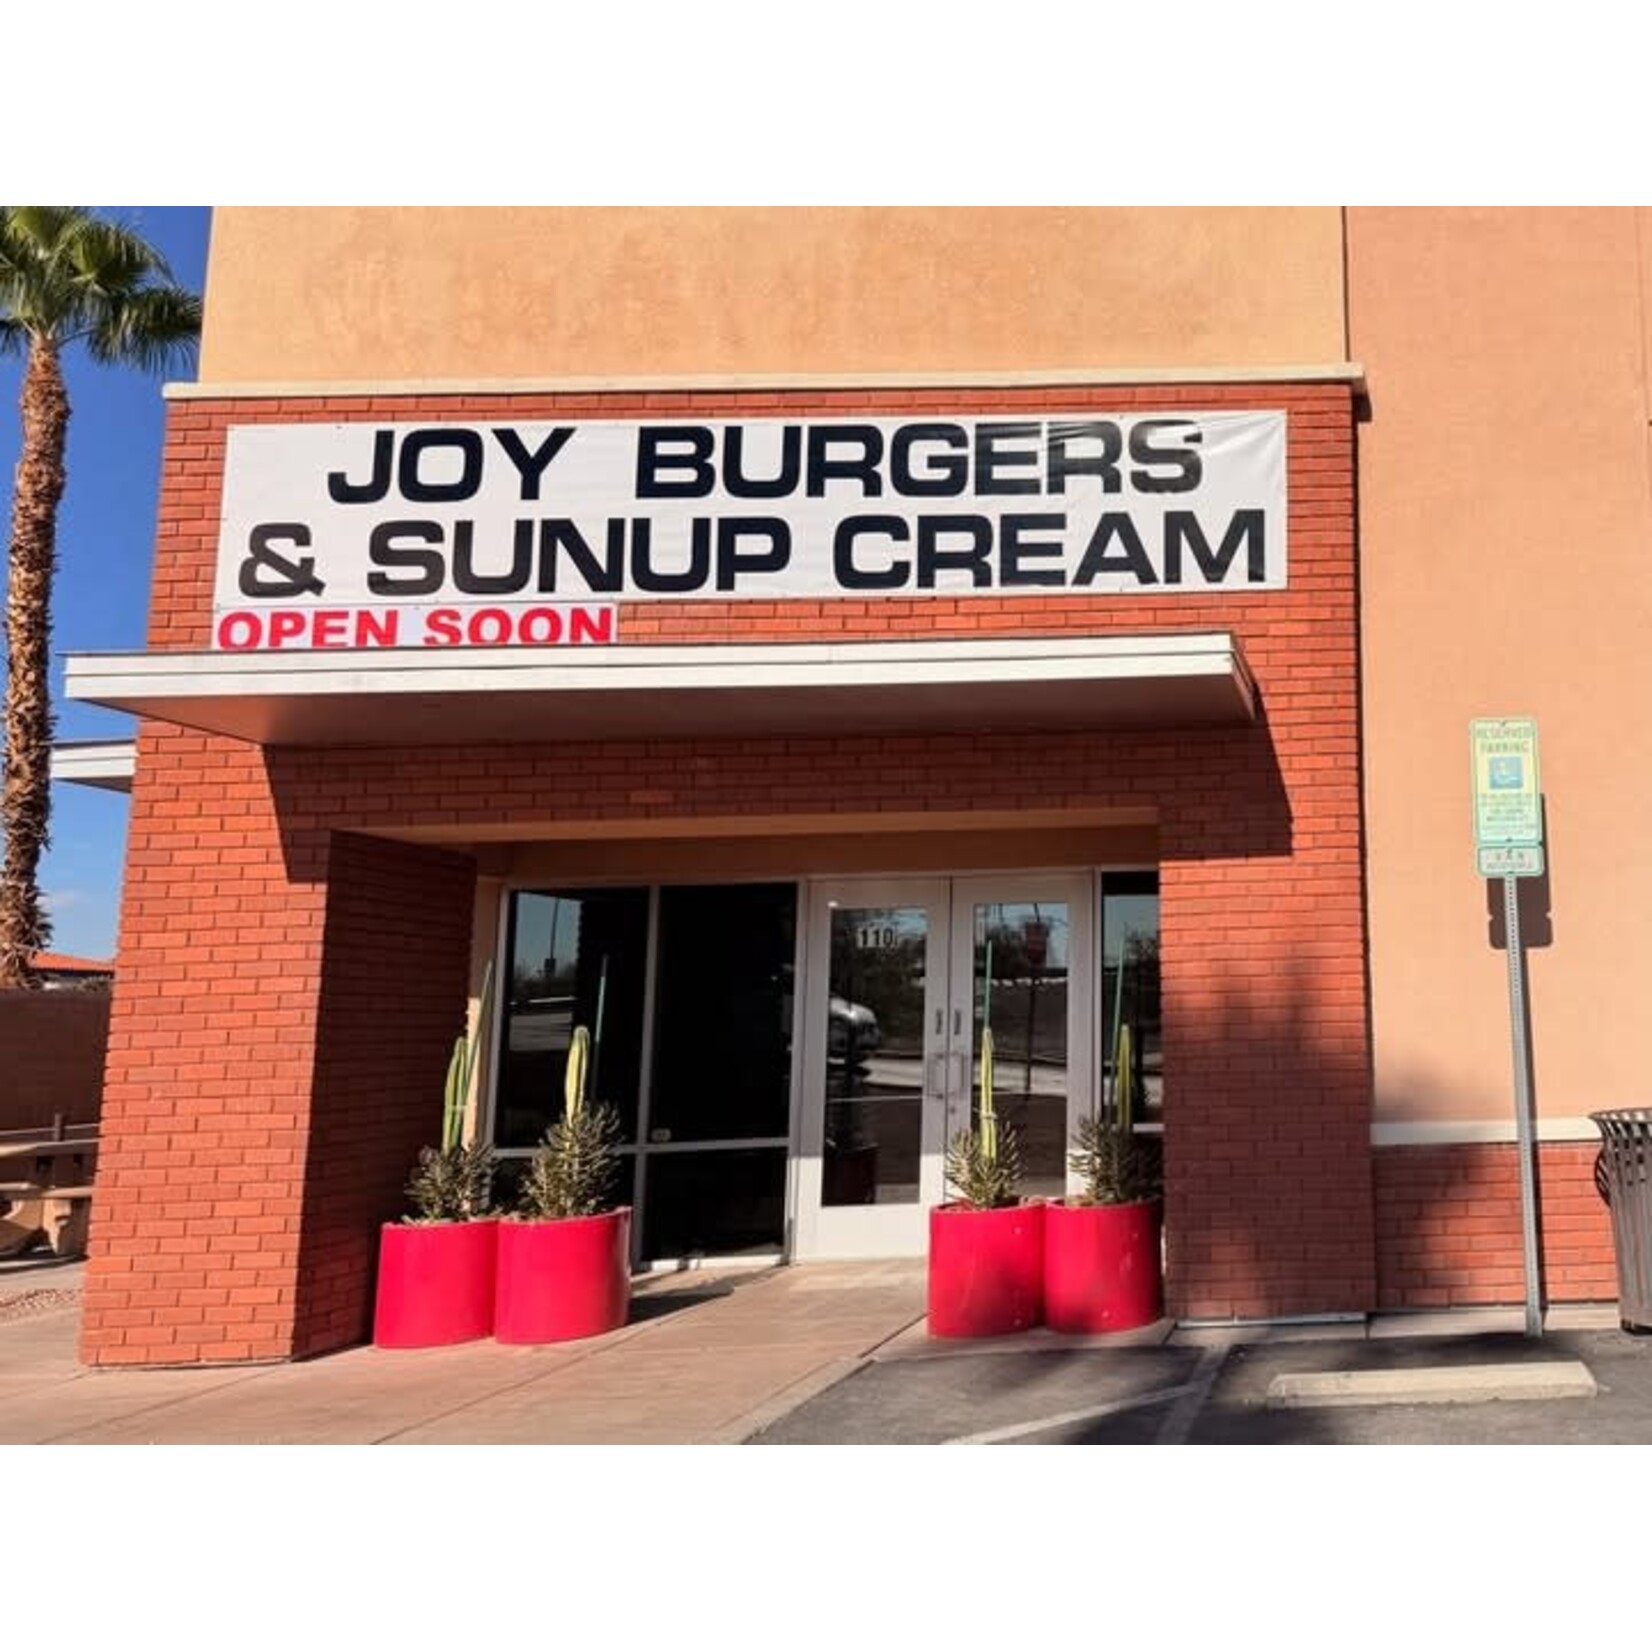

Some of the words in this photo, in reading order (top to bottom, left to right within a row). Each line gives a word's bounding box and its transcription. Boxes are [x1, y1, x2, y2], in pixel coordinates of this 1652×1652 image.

[327, 426, 577, 505] JOY
[635, 419, 1203, 501] BURGERS
[238, 522, 326, 598] &
[366, 516, 792, 597] SUNUP
[833, 508, 1266, 590] CREAM
[217, 608, 399, 651] OPEN
[422, 606, 614, 647] SOON
[861, 927, 895, 946] 110
